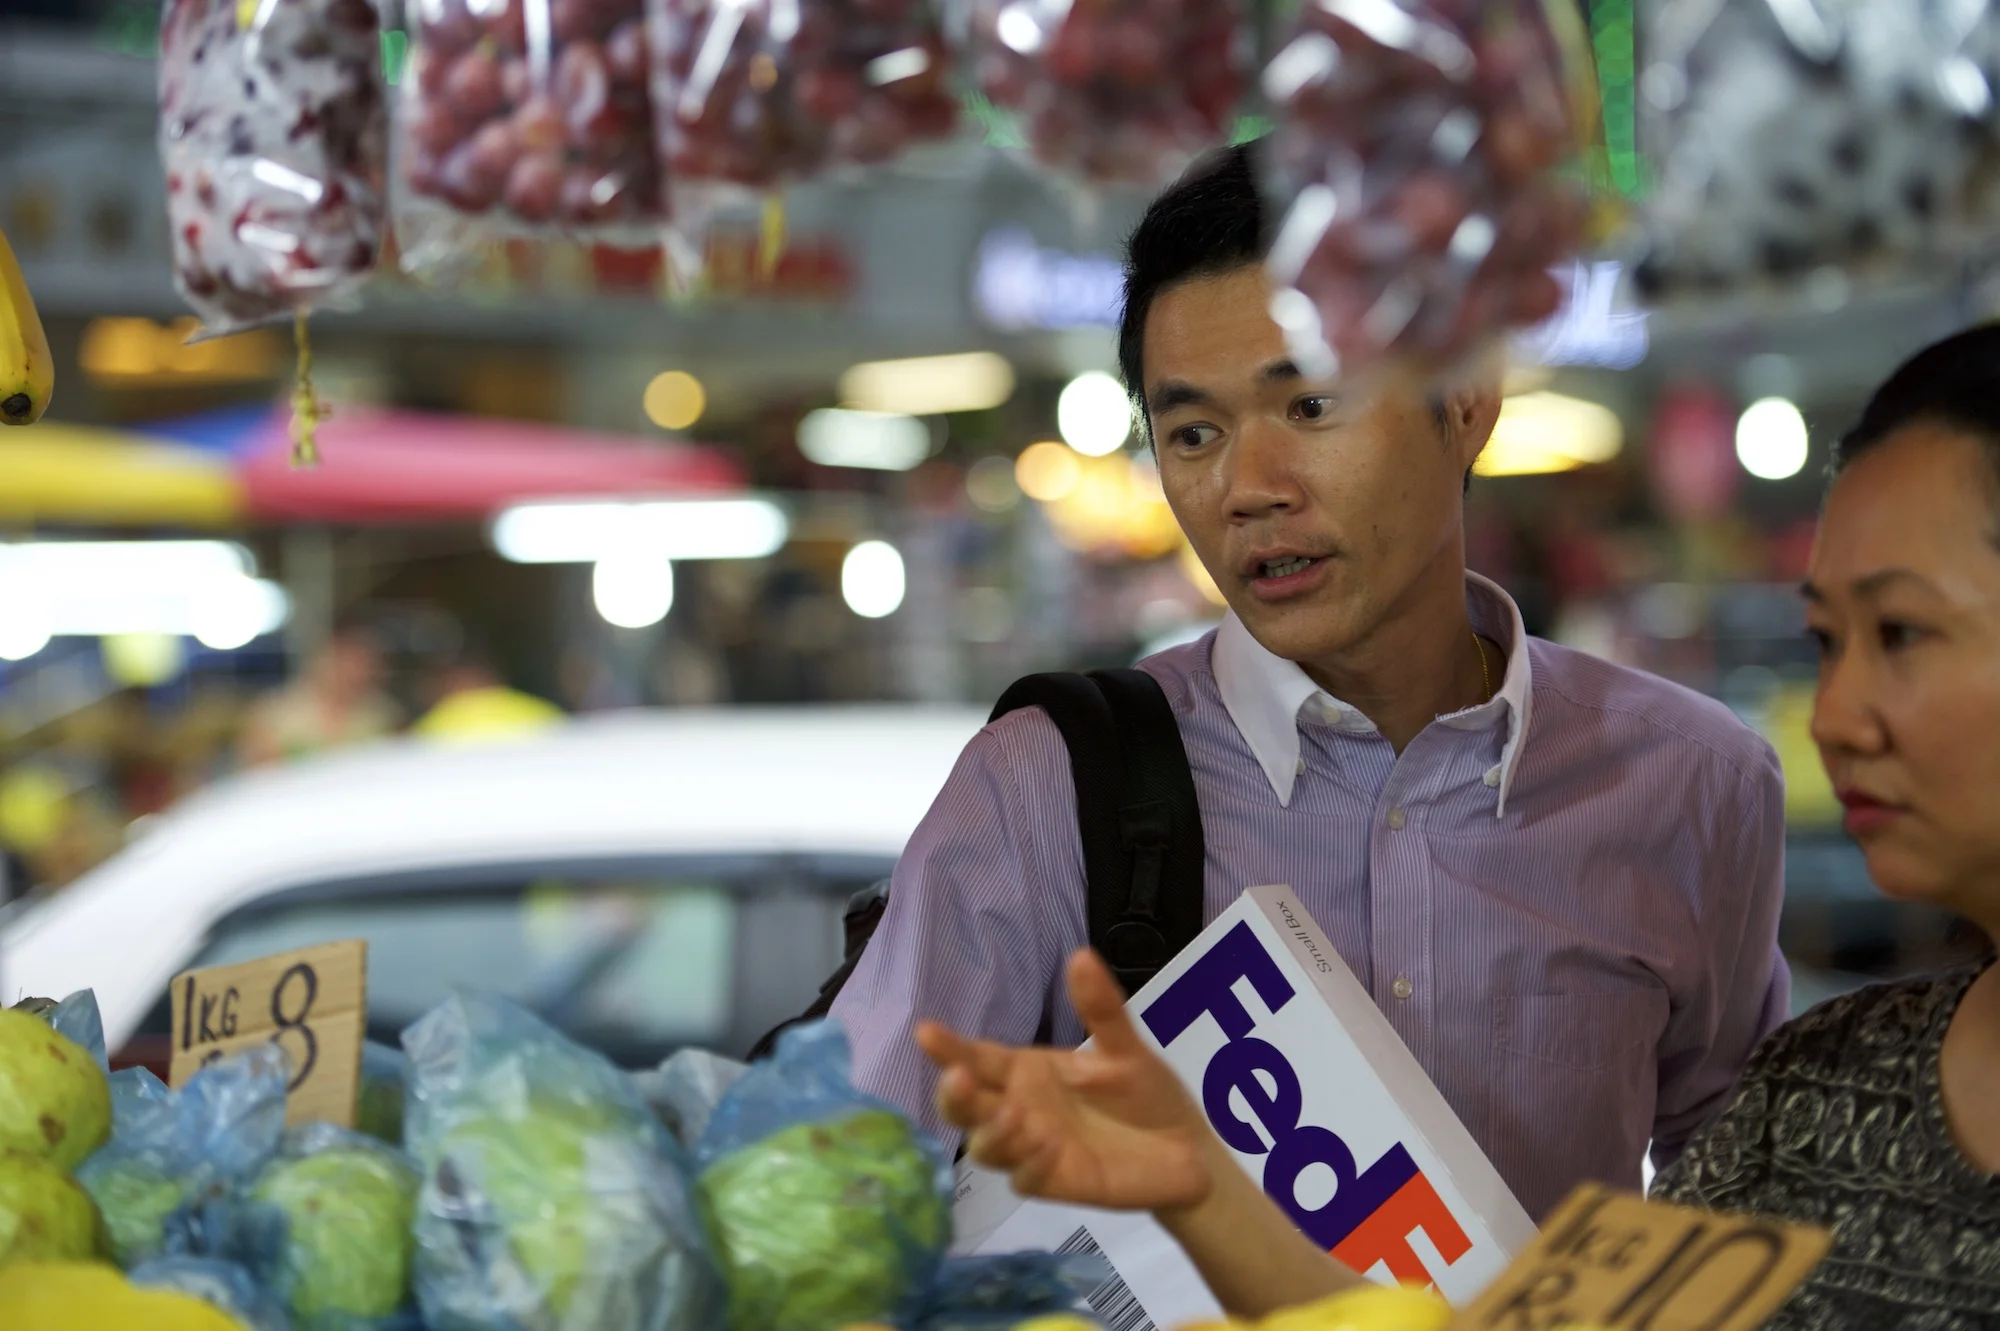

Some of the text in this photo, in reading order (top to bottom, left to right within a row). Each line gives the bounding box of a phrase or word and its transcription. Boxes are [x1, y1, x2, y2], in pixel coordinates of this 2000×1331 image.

[1275, 900, 1332, 973] Small Box
[270, 962, 318, 1093] 8
[1140, 919, 1474, 1304] FedE
[1602, 1218, 1788, 1331] 10
